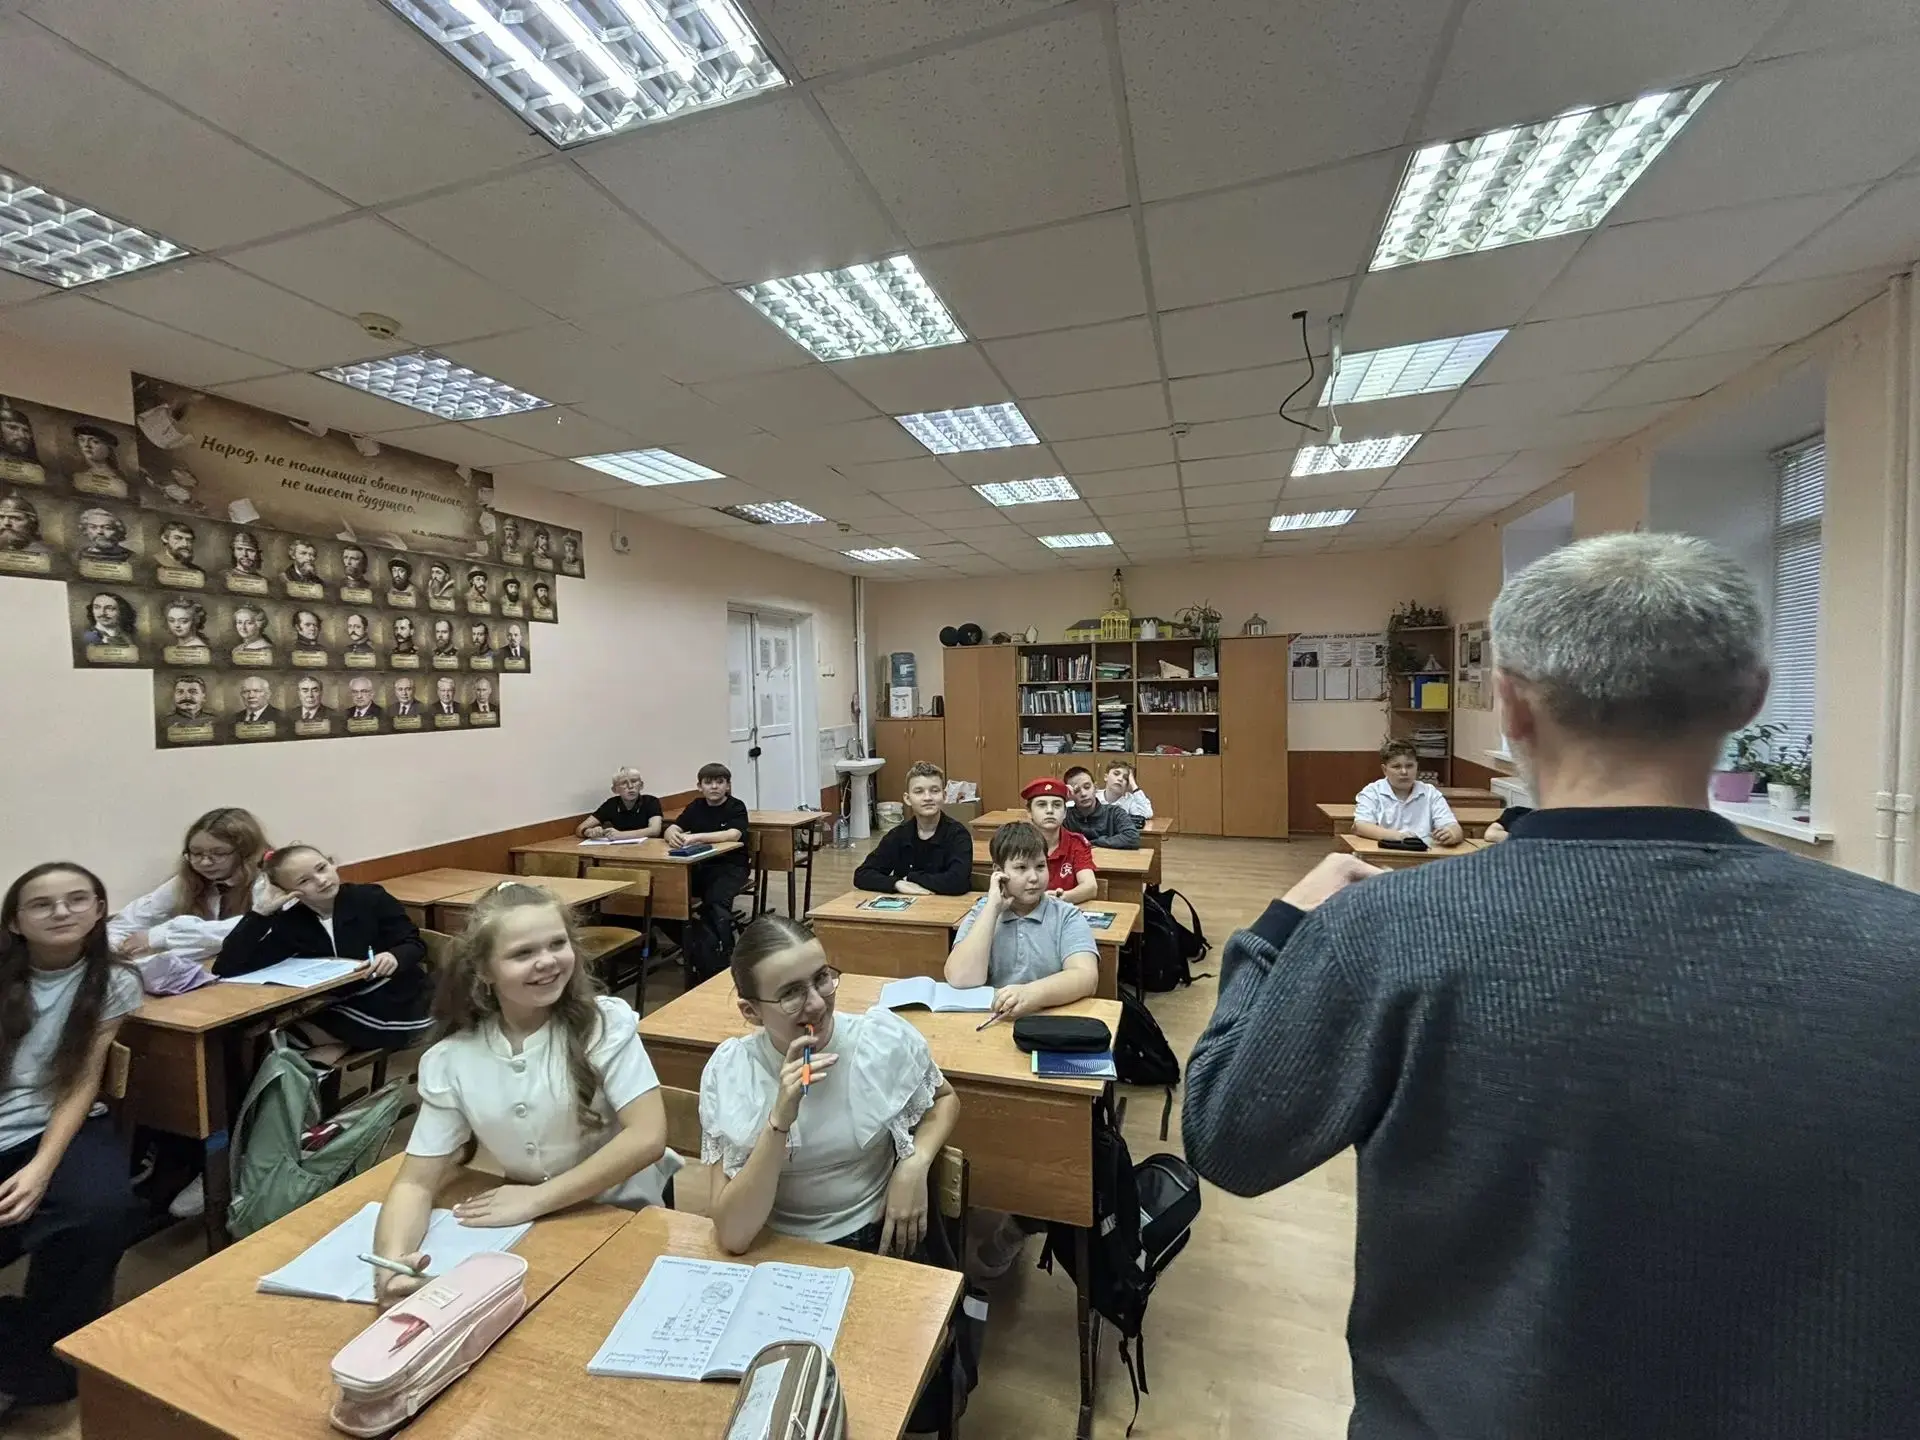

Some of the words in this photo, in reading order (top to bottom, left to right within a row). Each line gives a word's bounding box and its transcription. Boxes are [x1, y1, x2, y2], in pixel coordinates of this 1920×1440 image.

[200, 435, 258, 464] Народ,
[264, 454, 285, 467] не
[289, 459, 367, 485] помнящий
[370, 476, 408, 495] своего
[281, 478, 301, 489] не
[304, 482, 353, 501] имеет
[357, 489, 416, 514] будущего.
